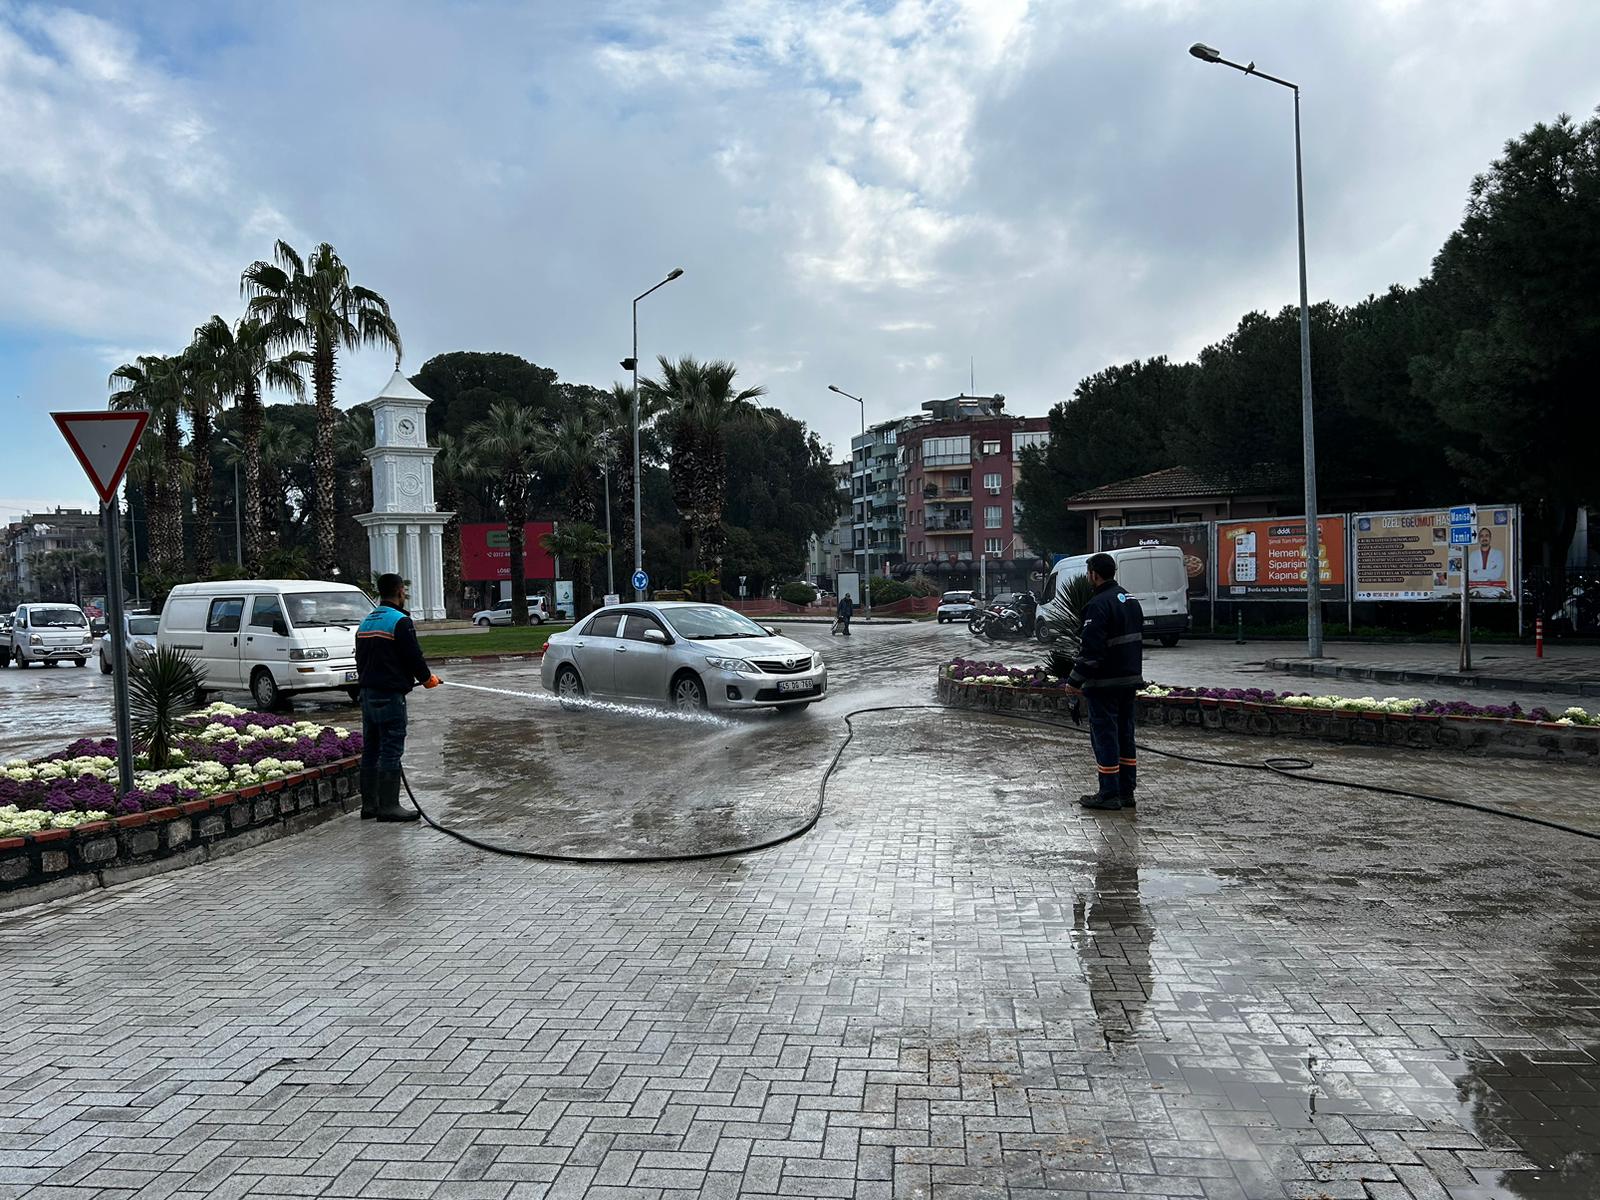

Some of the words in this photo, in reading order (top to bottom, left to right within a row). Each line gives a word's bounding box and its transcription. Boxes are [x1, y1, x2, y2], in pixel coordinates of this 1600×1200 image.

[1453, 528, 1470, 543] İzmir
[1268, 549, 1300, 558] Hemen
[1268, 571, 1299, 581] Kapına
